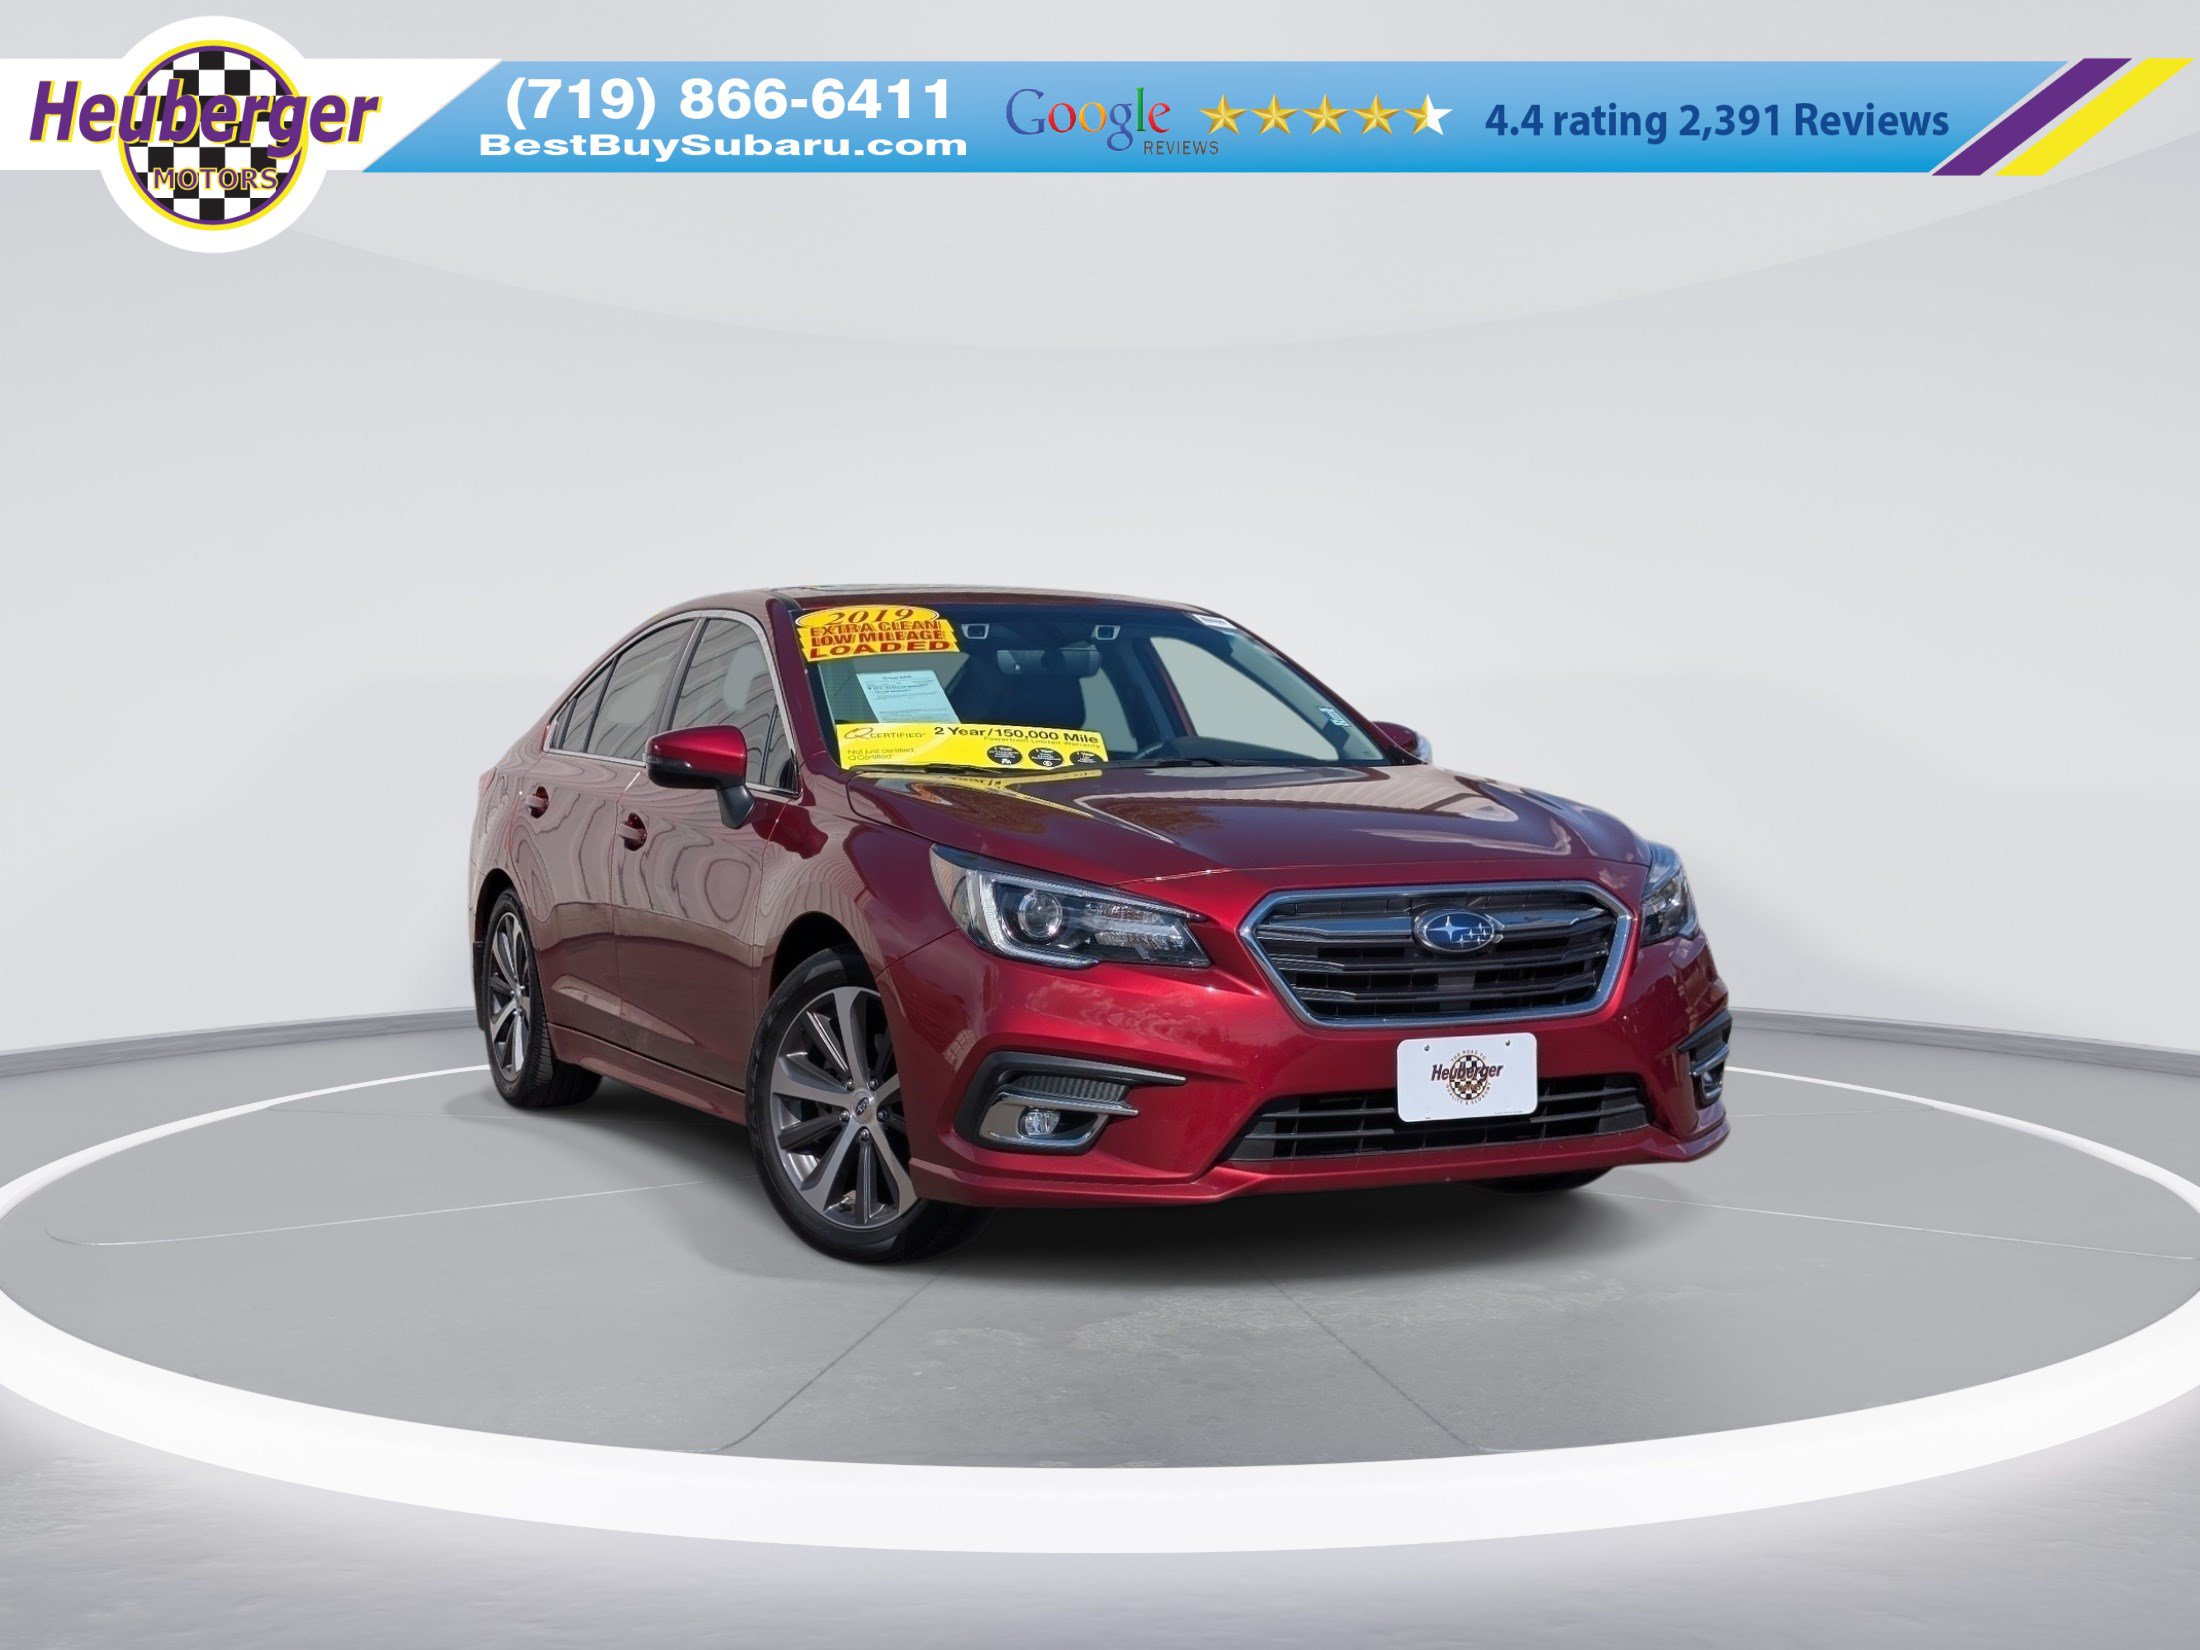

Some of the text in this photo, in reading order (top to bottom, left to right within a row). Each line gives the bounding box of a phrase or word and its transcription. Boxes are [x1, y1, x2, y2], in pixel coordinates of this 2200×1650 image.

[826, 608, 914, 626] 2019
[810, 620, 942, 637] EXTRA CLEAN
[811, 630, 944, 647] LOW MILEAGE
[810, 640, 950, 659] LOADED
[934, 726, 1099, 743] 2 Year/150,000 Mile
[1431, 1062, 1504, 1082] Heuberger
